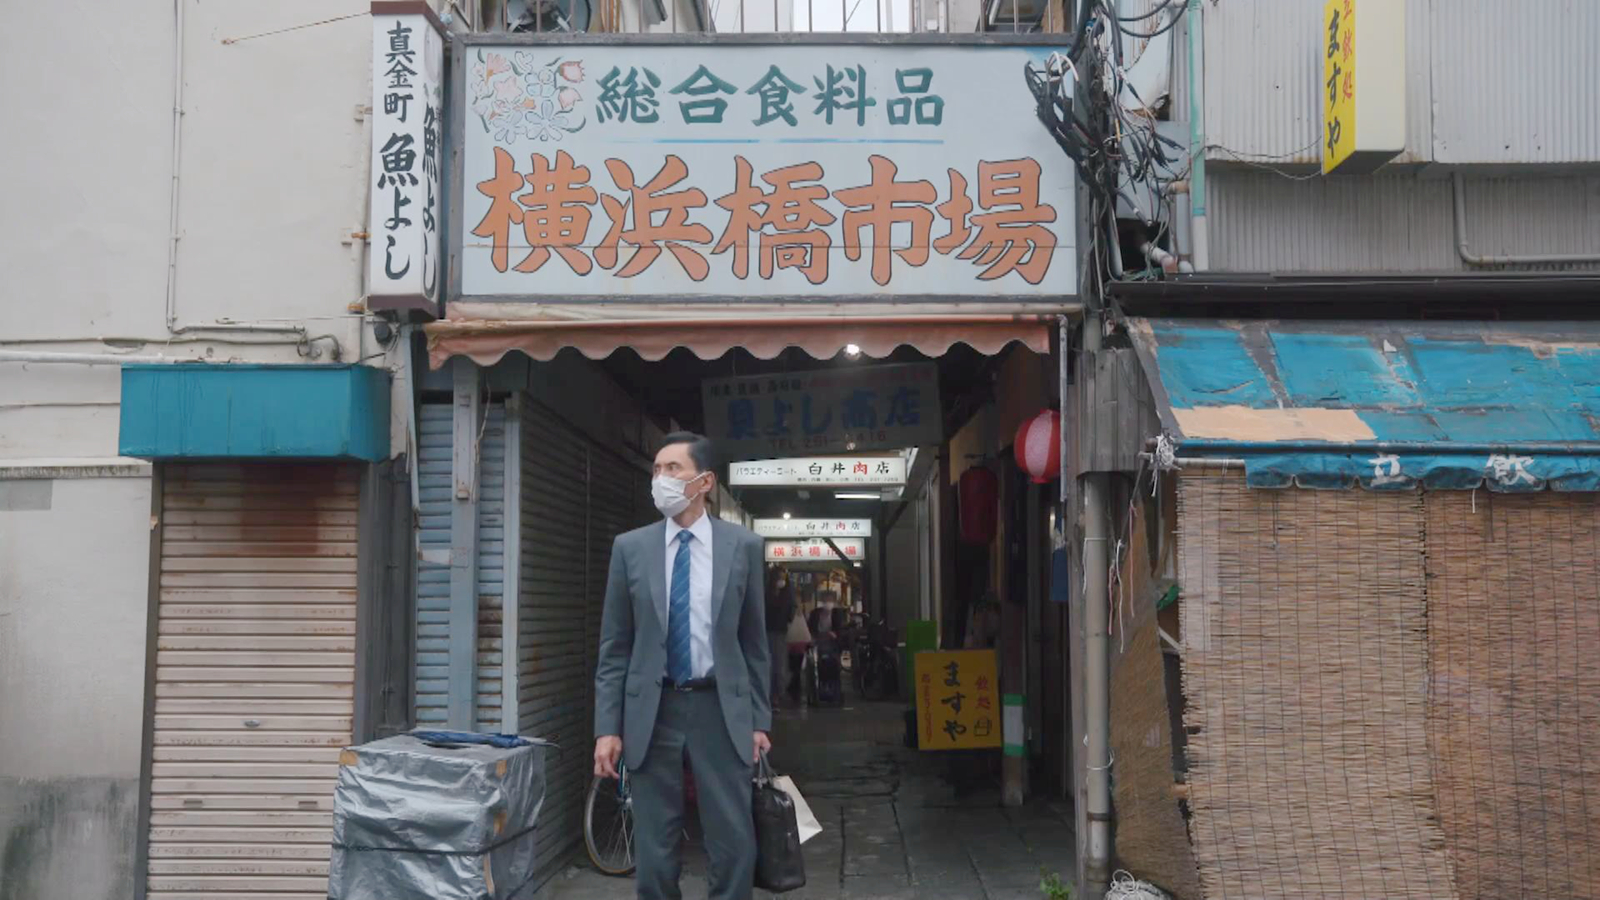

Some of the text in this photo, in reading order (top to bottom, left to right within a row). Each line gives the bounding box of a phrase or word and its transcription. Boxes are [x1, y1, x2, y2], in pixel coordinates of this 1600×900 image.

[595, 64, 945, 127] 総合食料品
[1326, 8, 1341, 159] ますや
[377, 20, 419, 281] 真金町 魚よし
[470, 146, 1058, 287] 横浜橋市場
[808, 461, 890, 475] 白井肉店
[941, 661, 968, 742] ますや
